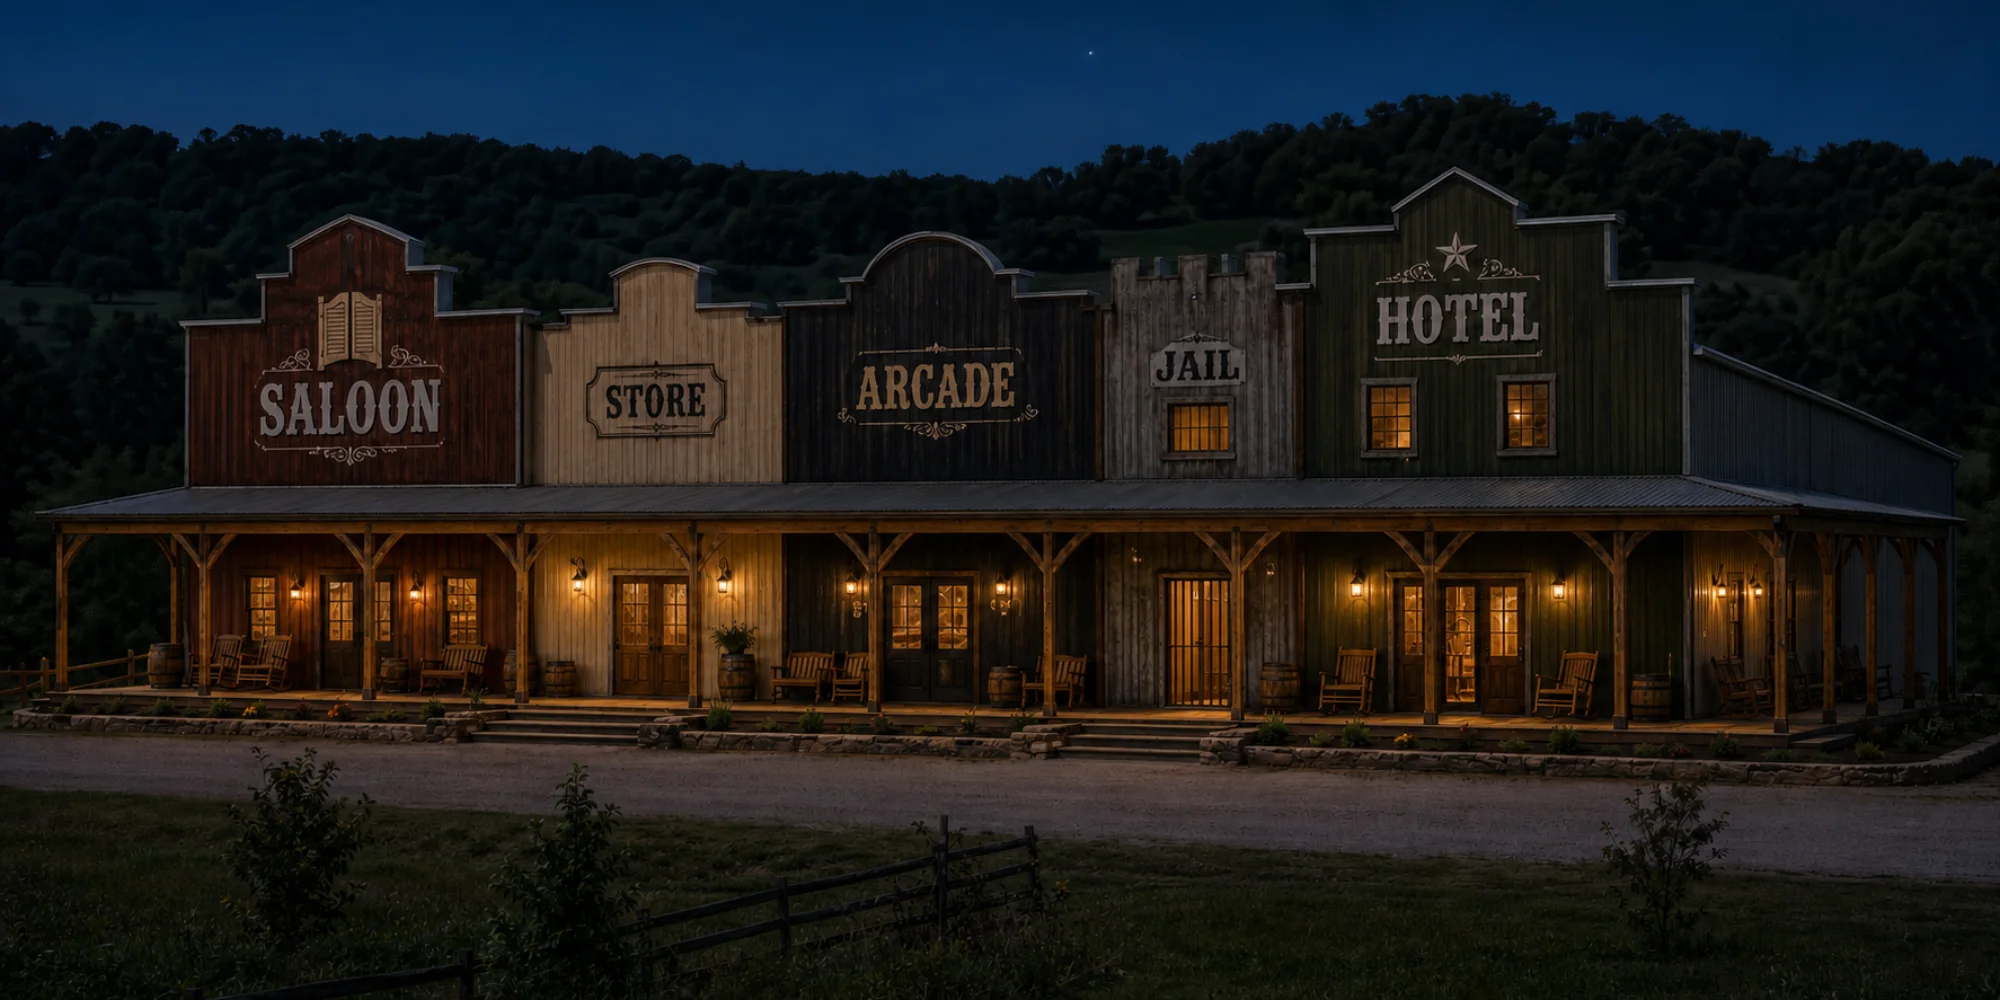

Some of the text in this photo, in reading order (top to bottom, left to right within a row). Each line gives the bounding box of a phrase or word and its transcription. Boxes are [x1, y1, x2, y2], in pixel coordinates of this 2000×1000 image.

[1376, 291, 1540, 345] HOTEL
[855, 361, 1016, 411] ARCADE
[1156, 350, 1240, 382] JAIL
[259, 378, 441, 437] SALOON
[605, 382, 706, 420] STORE
